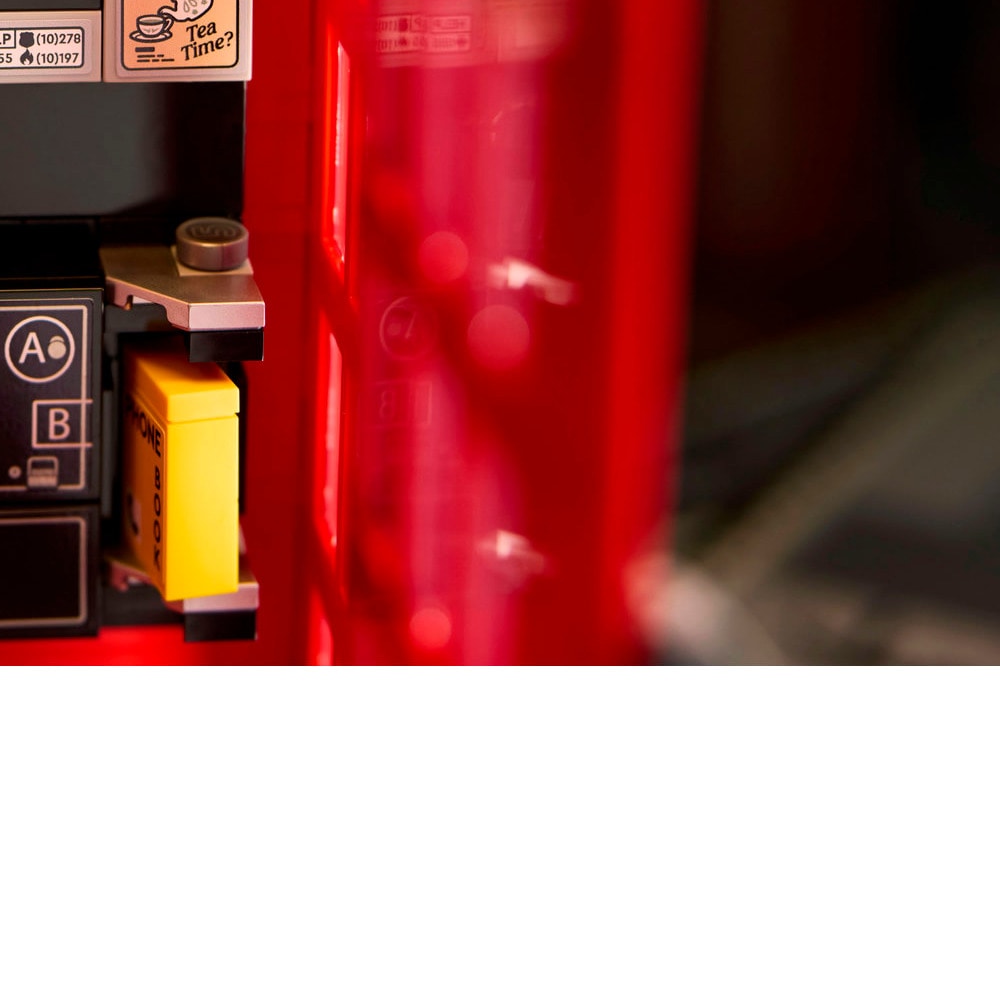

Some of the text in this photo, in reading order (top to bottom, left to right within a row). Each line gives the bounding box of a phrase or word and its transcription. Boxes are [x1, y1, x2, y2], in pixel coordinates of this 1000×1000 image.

[36, 33, 81, 46] (10)278
[186, 22, 217, 42] Tea
[36, 52, 80, 65] (10)197
[181, 31, 234, 61] Time?
[18, 331, 46, 364] A
[48, 407, 71, 440] B
